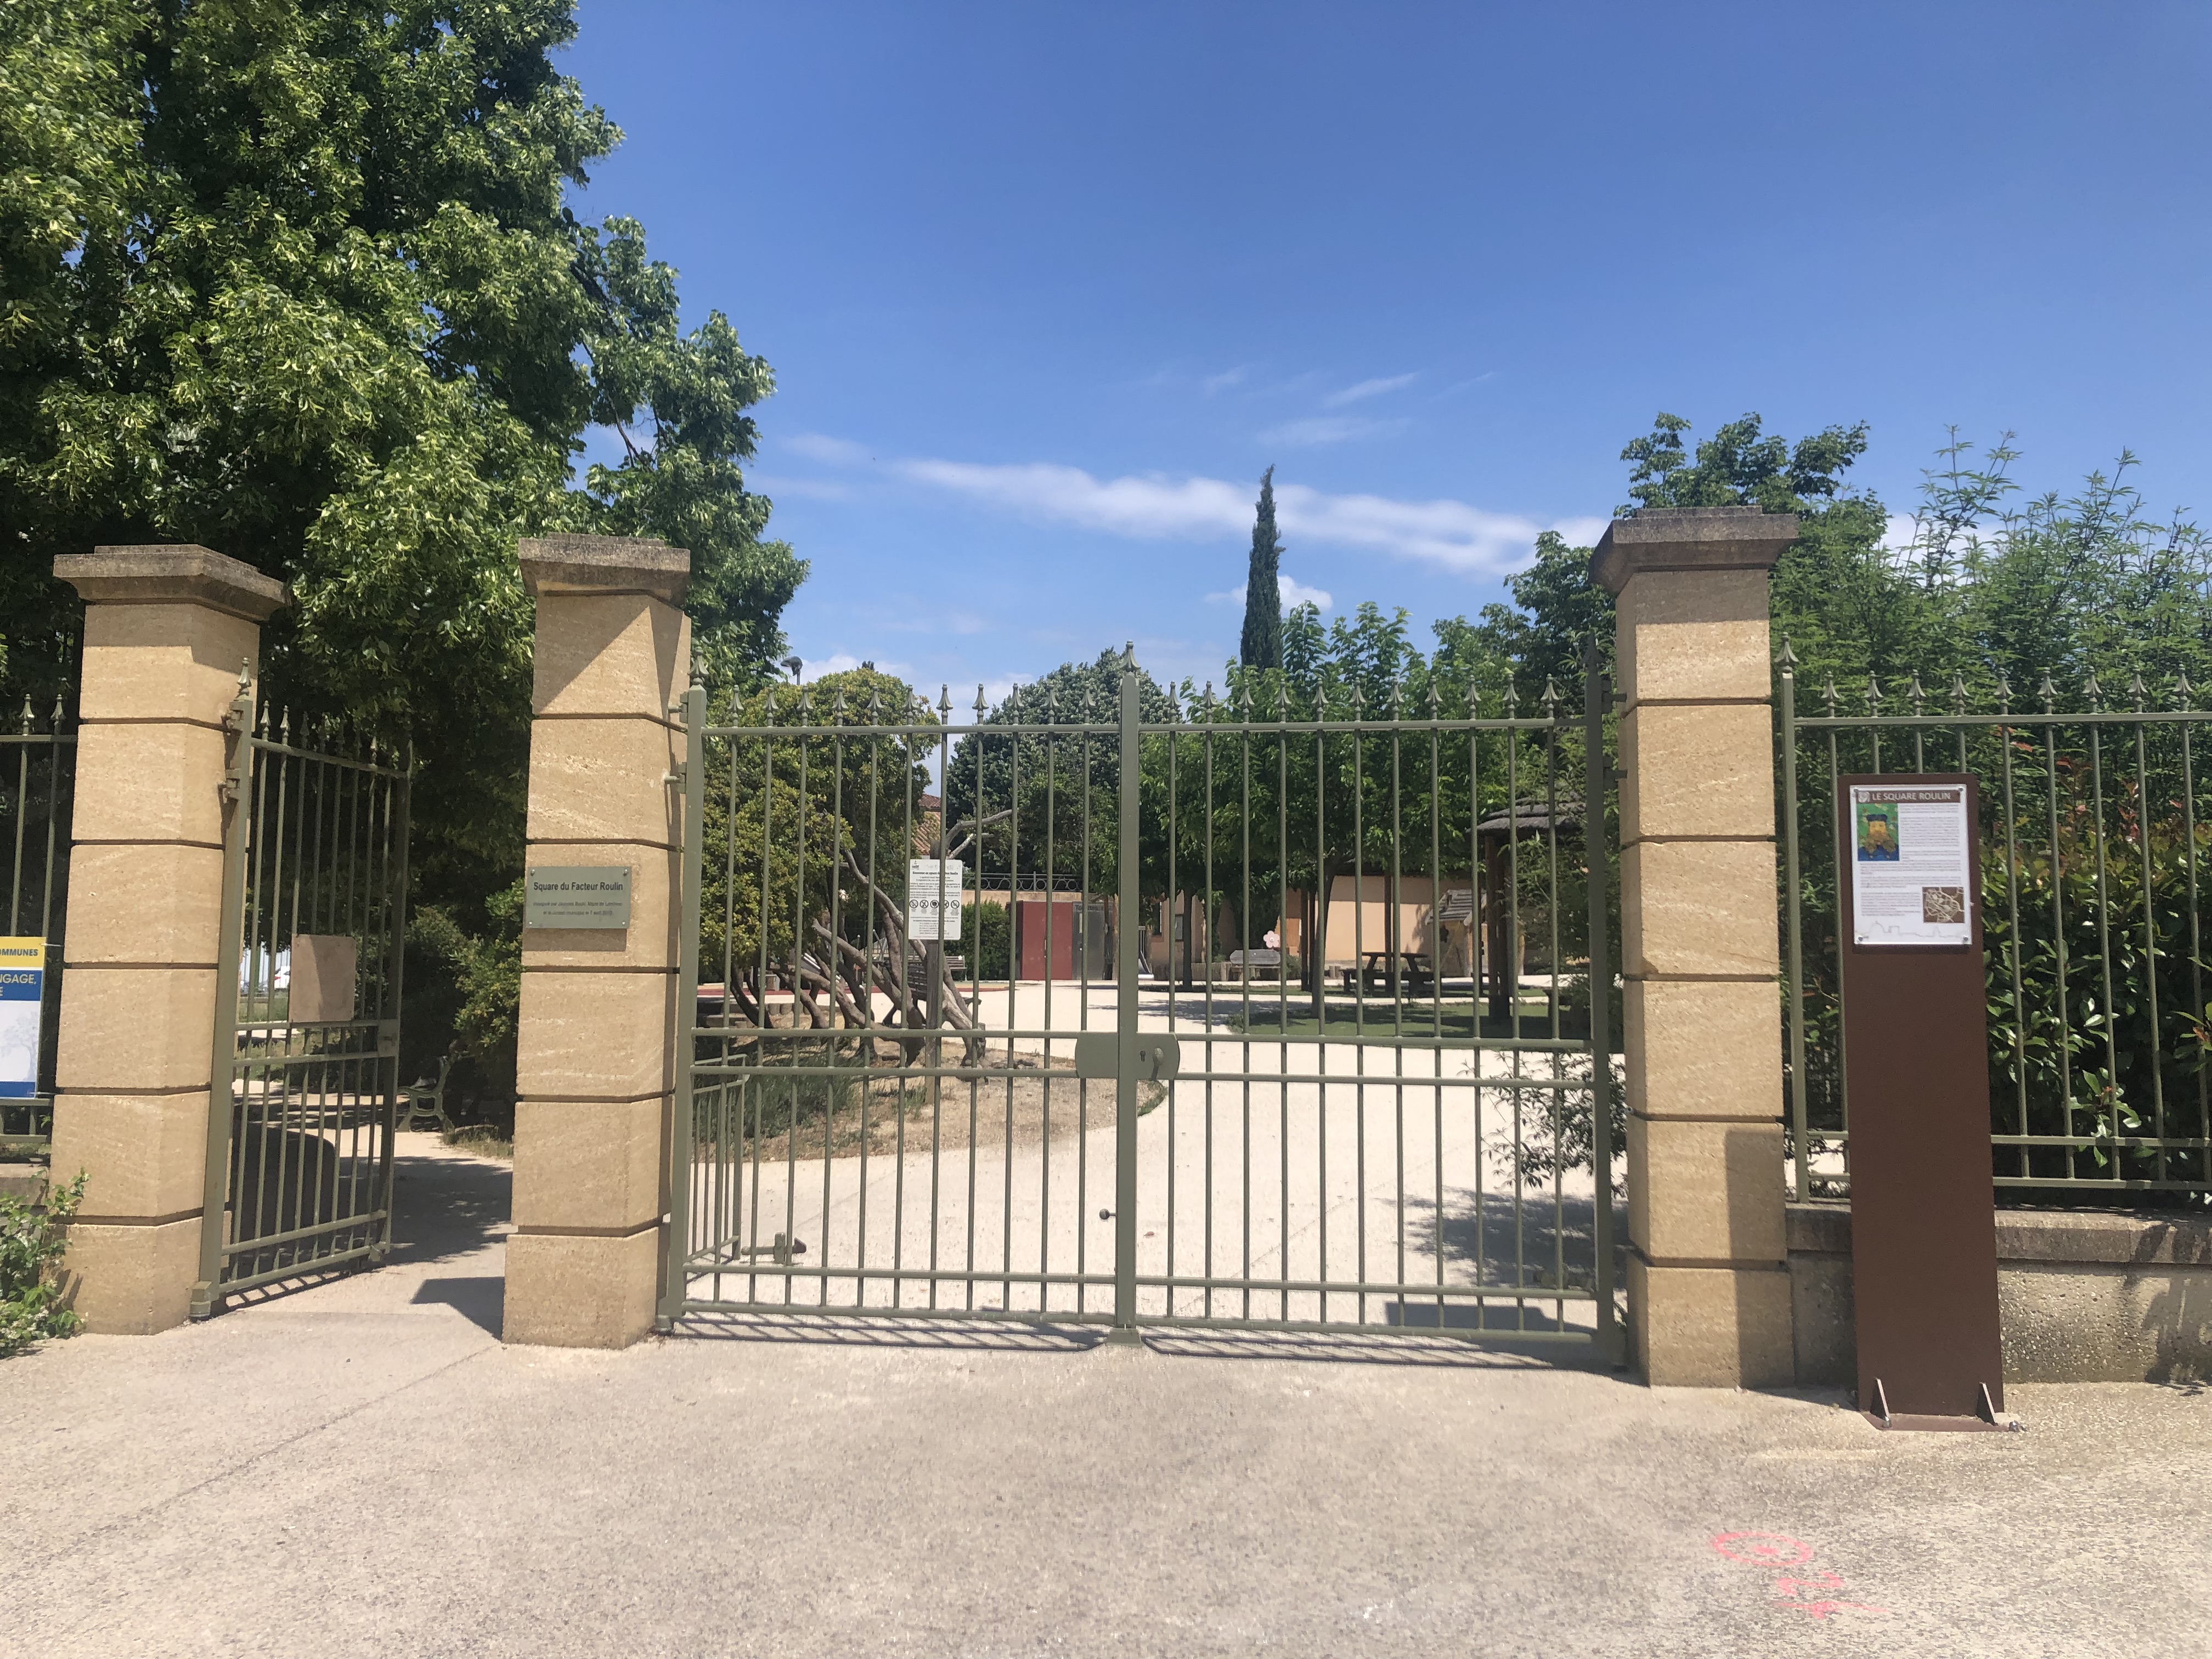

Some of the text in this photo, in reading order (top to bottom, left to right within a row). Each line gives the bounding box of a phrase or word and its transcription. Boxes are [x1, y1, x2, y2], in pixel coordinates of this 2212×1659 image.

[1883, 793, 1917, 801] SQUARE
[533, 882, 623, 892] Square du Facteur Roulin
[0, 948, 38, 956] MMUNES
